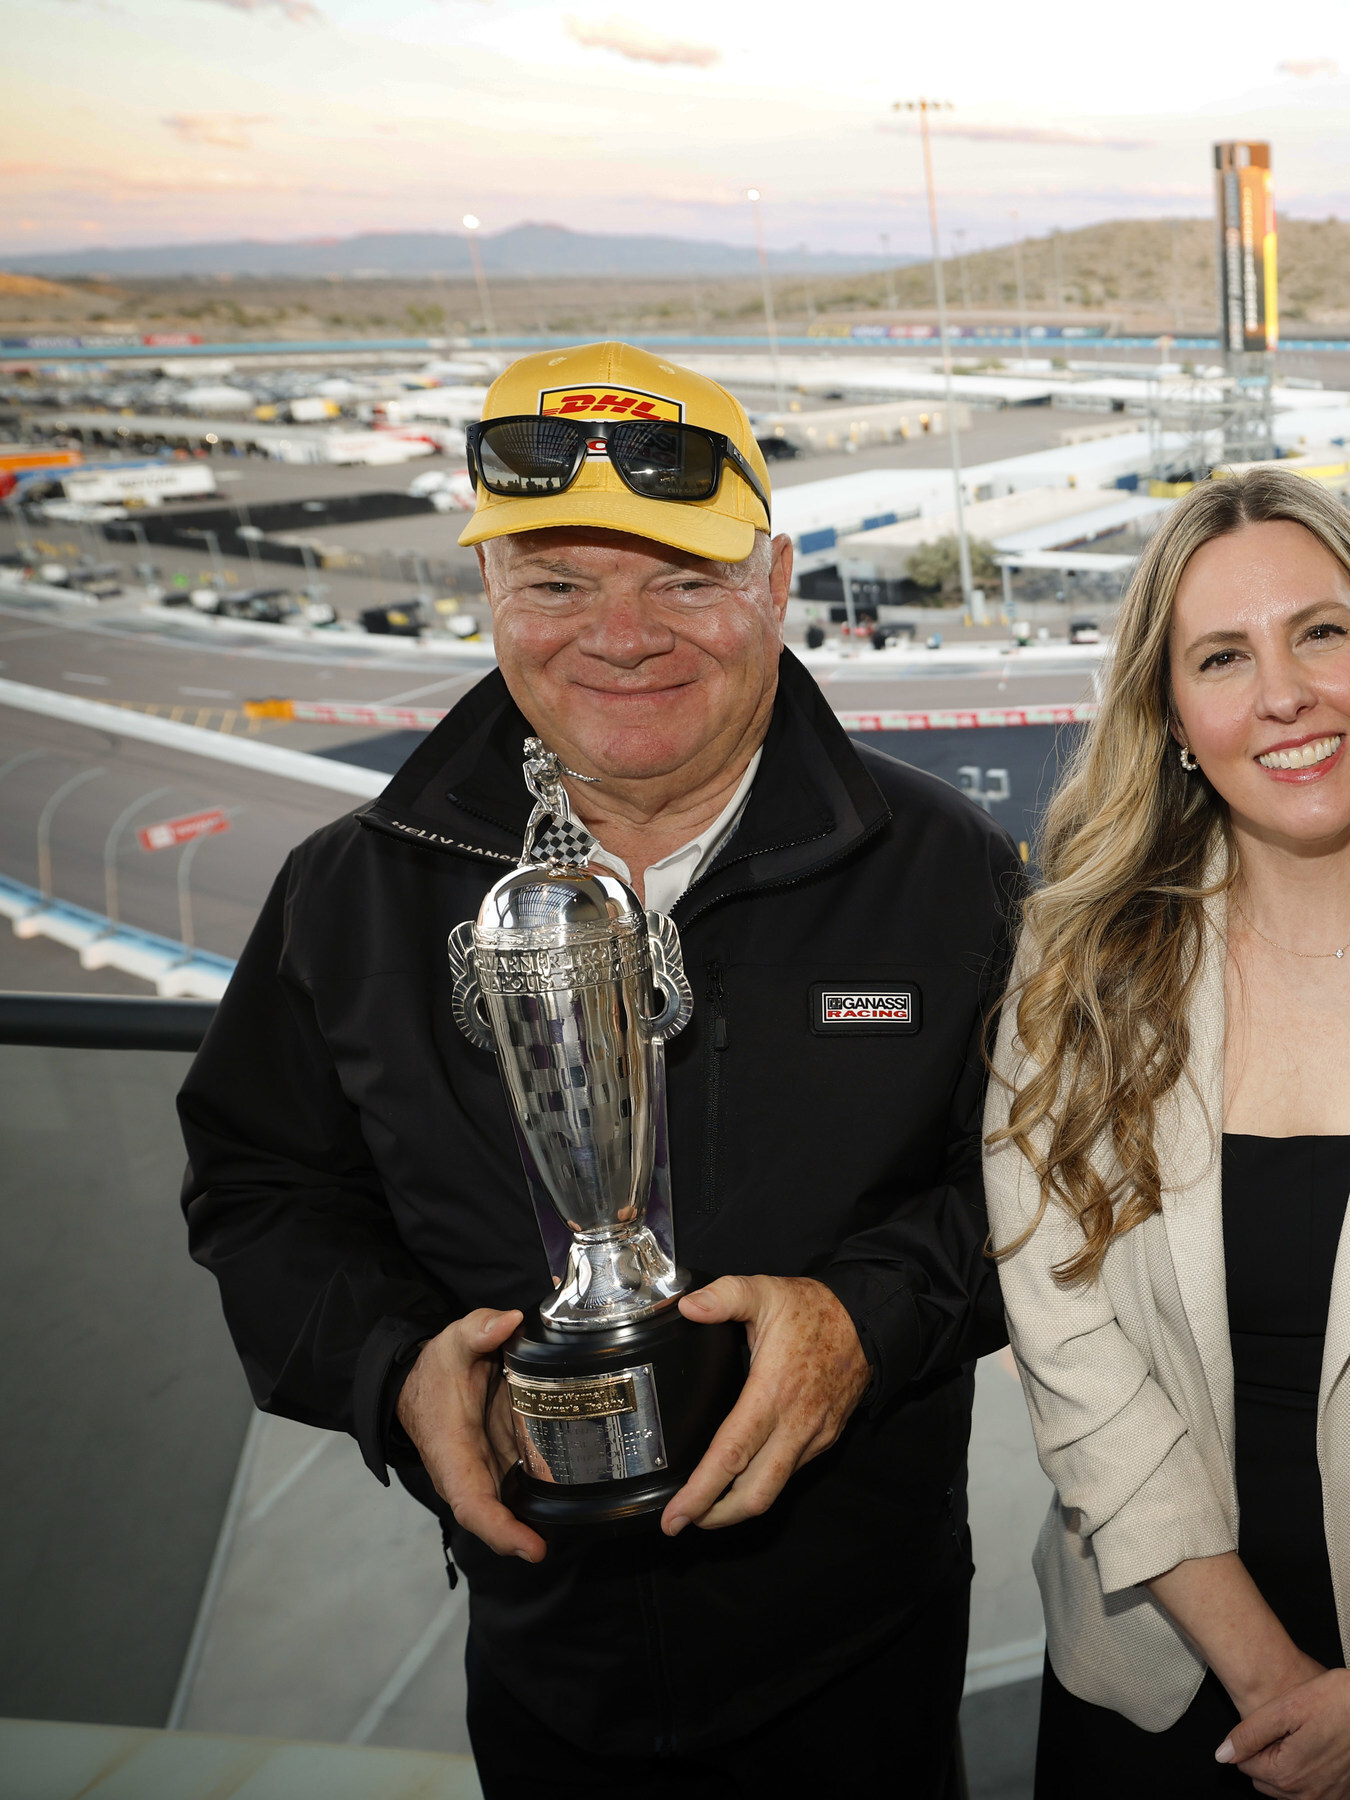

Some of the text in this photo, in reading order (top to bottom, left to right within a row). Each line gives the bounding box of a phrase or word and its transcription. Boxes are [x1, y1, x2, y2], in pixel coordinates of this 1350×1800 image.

[559, 394, 662, 420] DHL
[843, 997, 907, 1010] GANASSI
[828, 1010, 907, 1018] RACING
